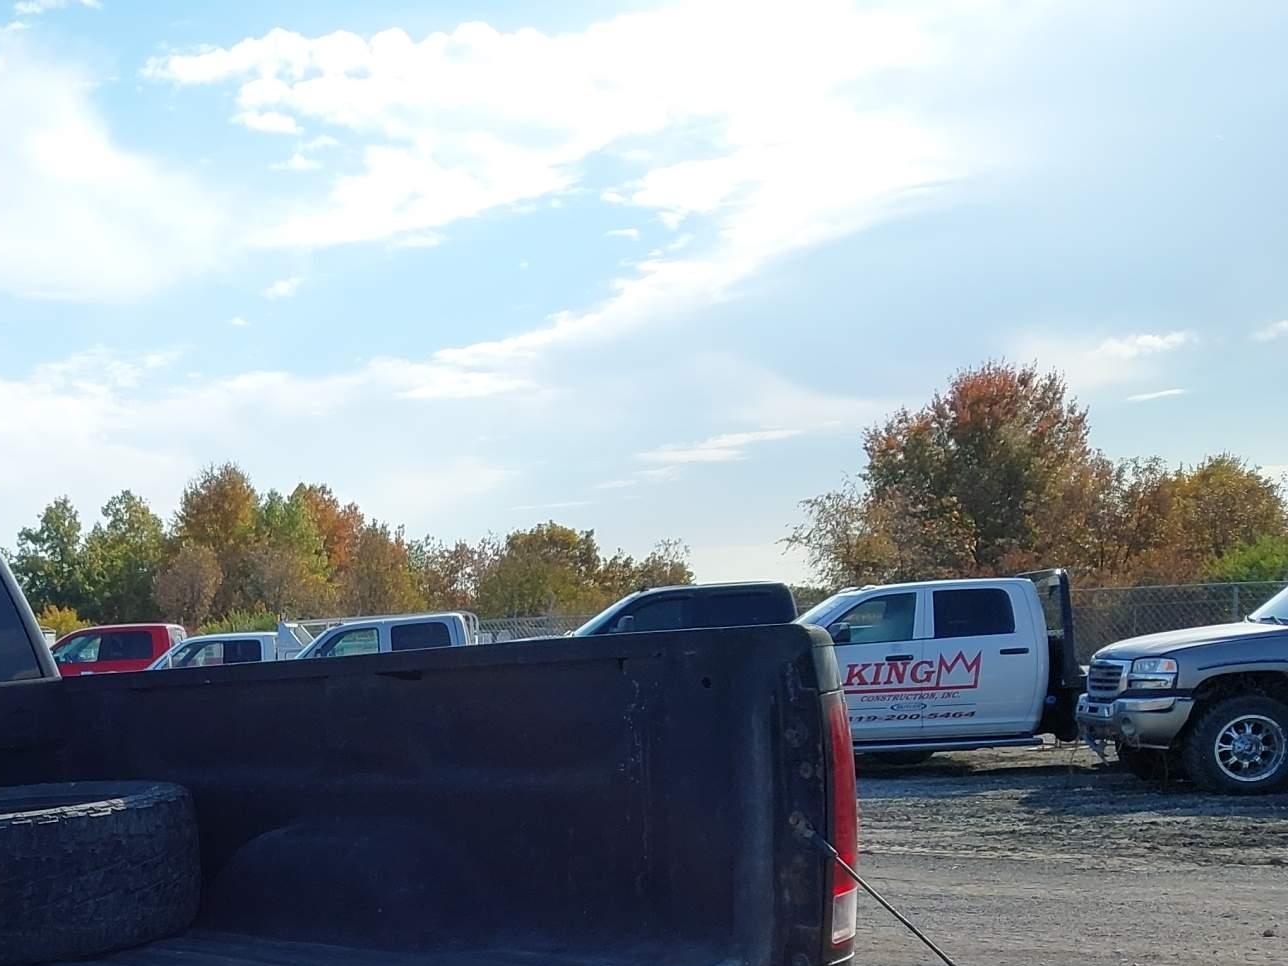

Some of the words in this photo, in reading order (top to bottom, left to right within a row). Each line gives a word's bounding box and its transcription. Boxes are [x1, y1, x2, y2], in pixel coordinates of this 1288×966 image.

[843, 660, 936, 686] KING
[860, 692, 938, 703] CONSTRUCTION,
[941, 691, 961, 699] INC.
